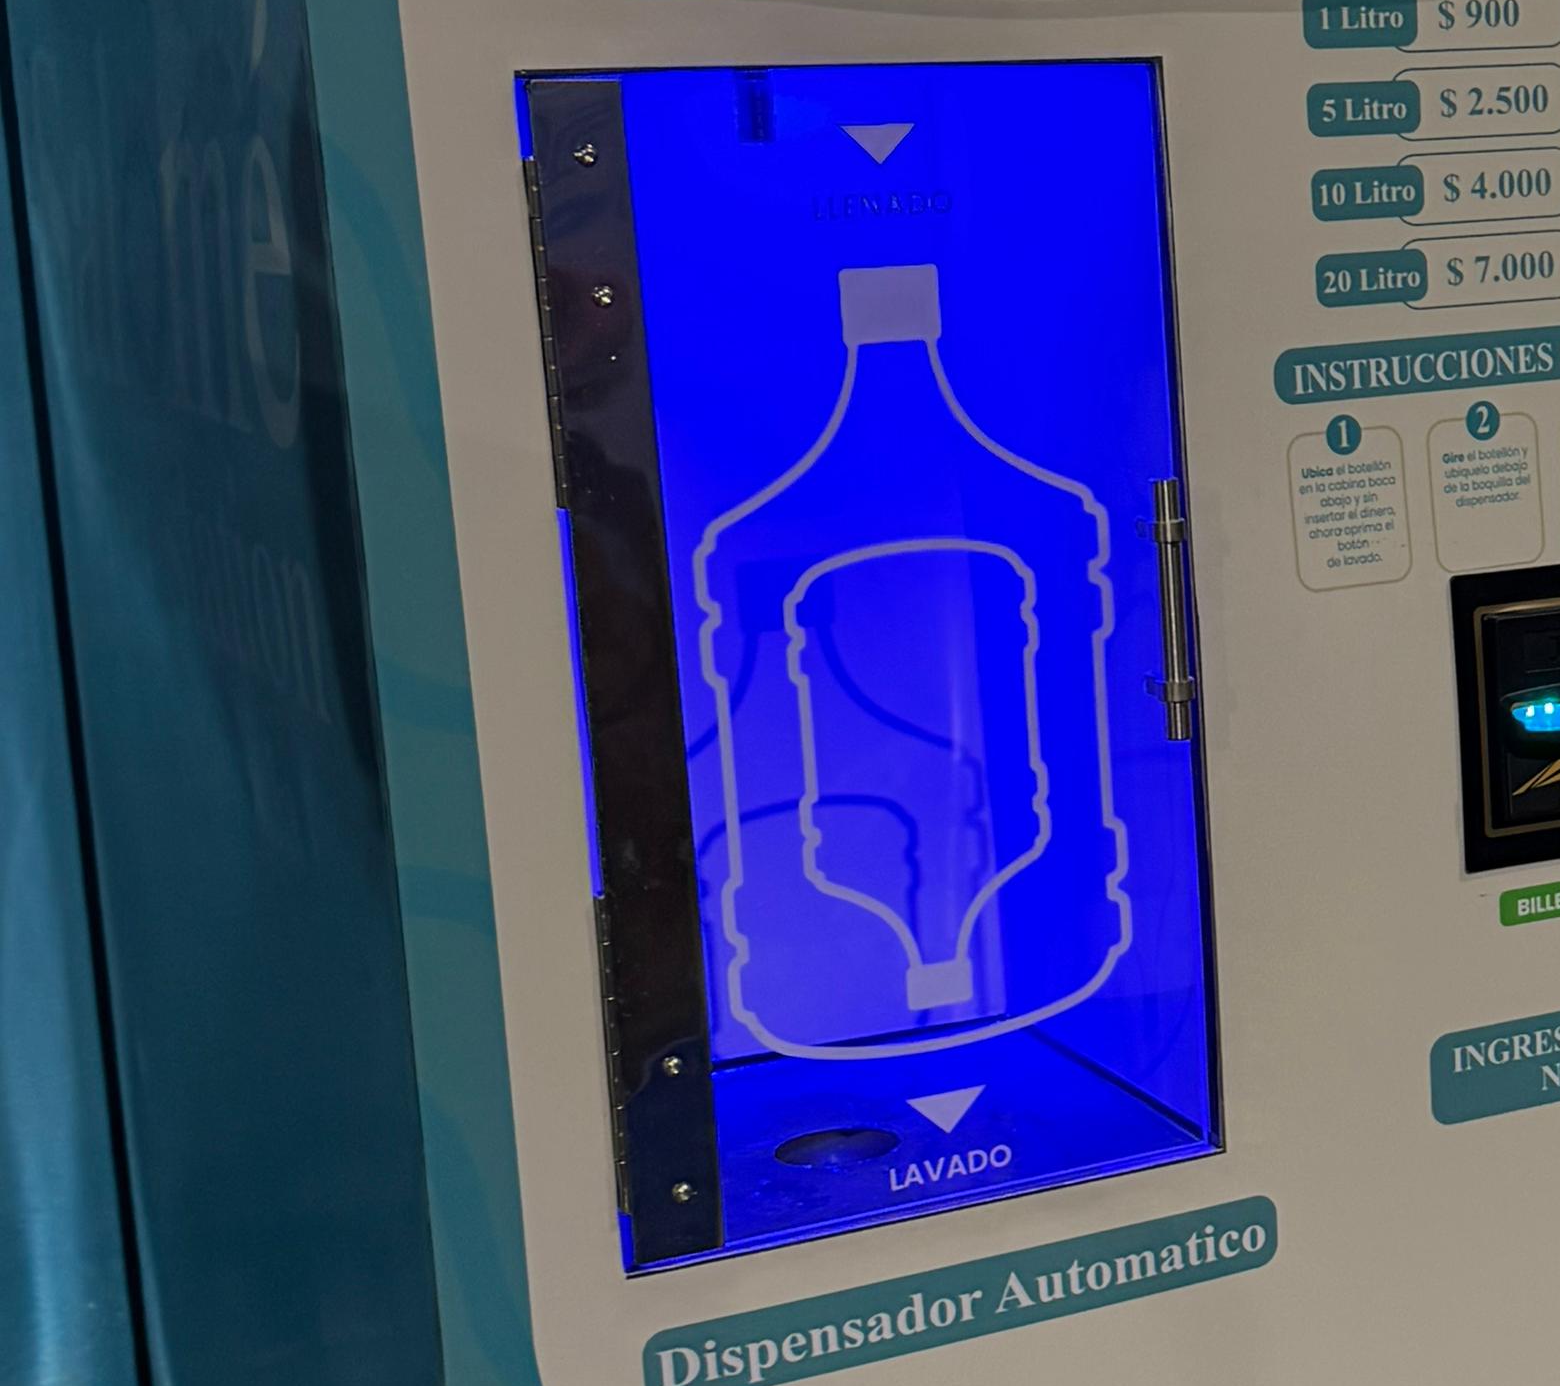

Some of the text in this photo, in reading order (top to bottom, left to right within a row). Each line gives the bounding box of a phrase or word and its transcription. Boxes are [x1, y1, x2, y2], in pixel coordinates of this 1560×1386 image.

[1320, 6, 1331, 30] 1
[1340, 3, 1404, 30] Litro
[1437, 0, 1456, 31] $
[1322, 84, 1549, 123] 5 Litro $ 2.500
[1319, 168, 1551, 207] 10 Litro $ 4.000
[1323, 251, 1555, 293] 20 Litro $ 7.000
[1294, 342, 1553, 396] INSTRUCCIONES
[1338, 420, 1350, 448] 1
[1475, 406, 1490, 434] 2
[1299, 476, 1396, 495] en la cabina boca
[1301, 465, 1333, 479] Ubica
[1336, 463, 1345, 475] el
[1320, 491, 1379, 509] abajo y sin
[1309, 520, 1394, 539] ahora oprima el
[888, 1143, 1013, 1192] LAVADO
[995, 1222, 1267, 1315] Automatico
